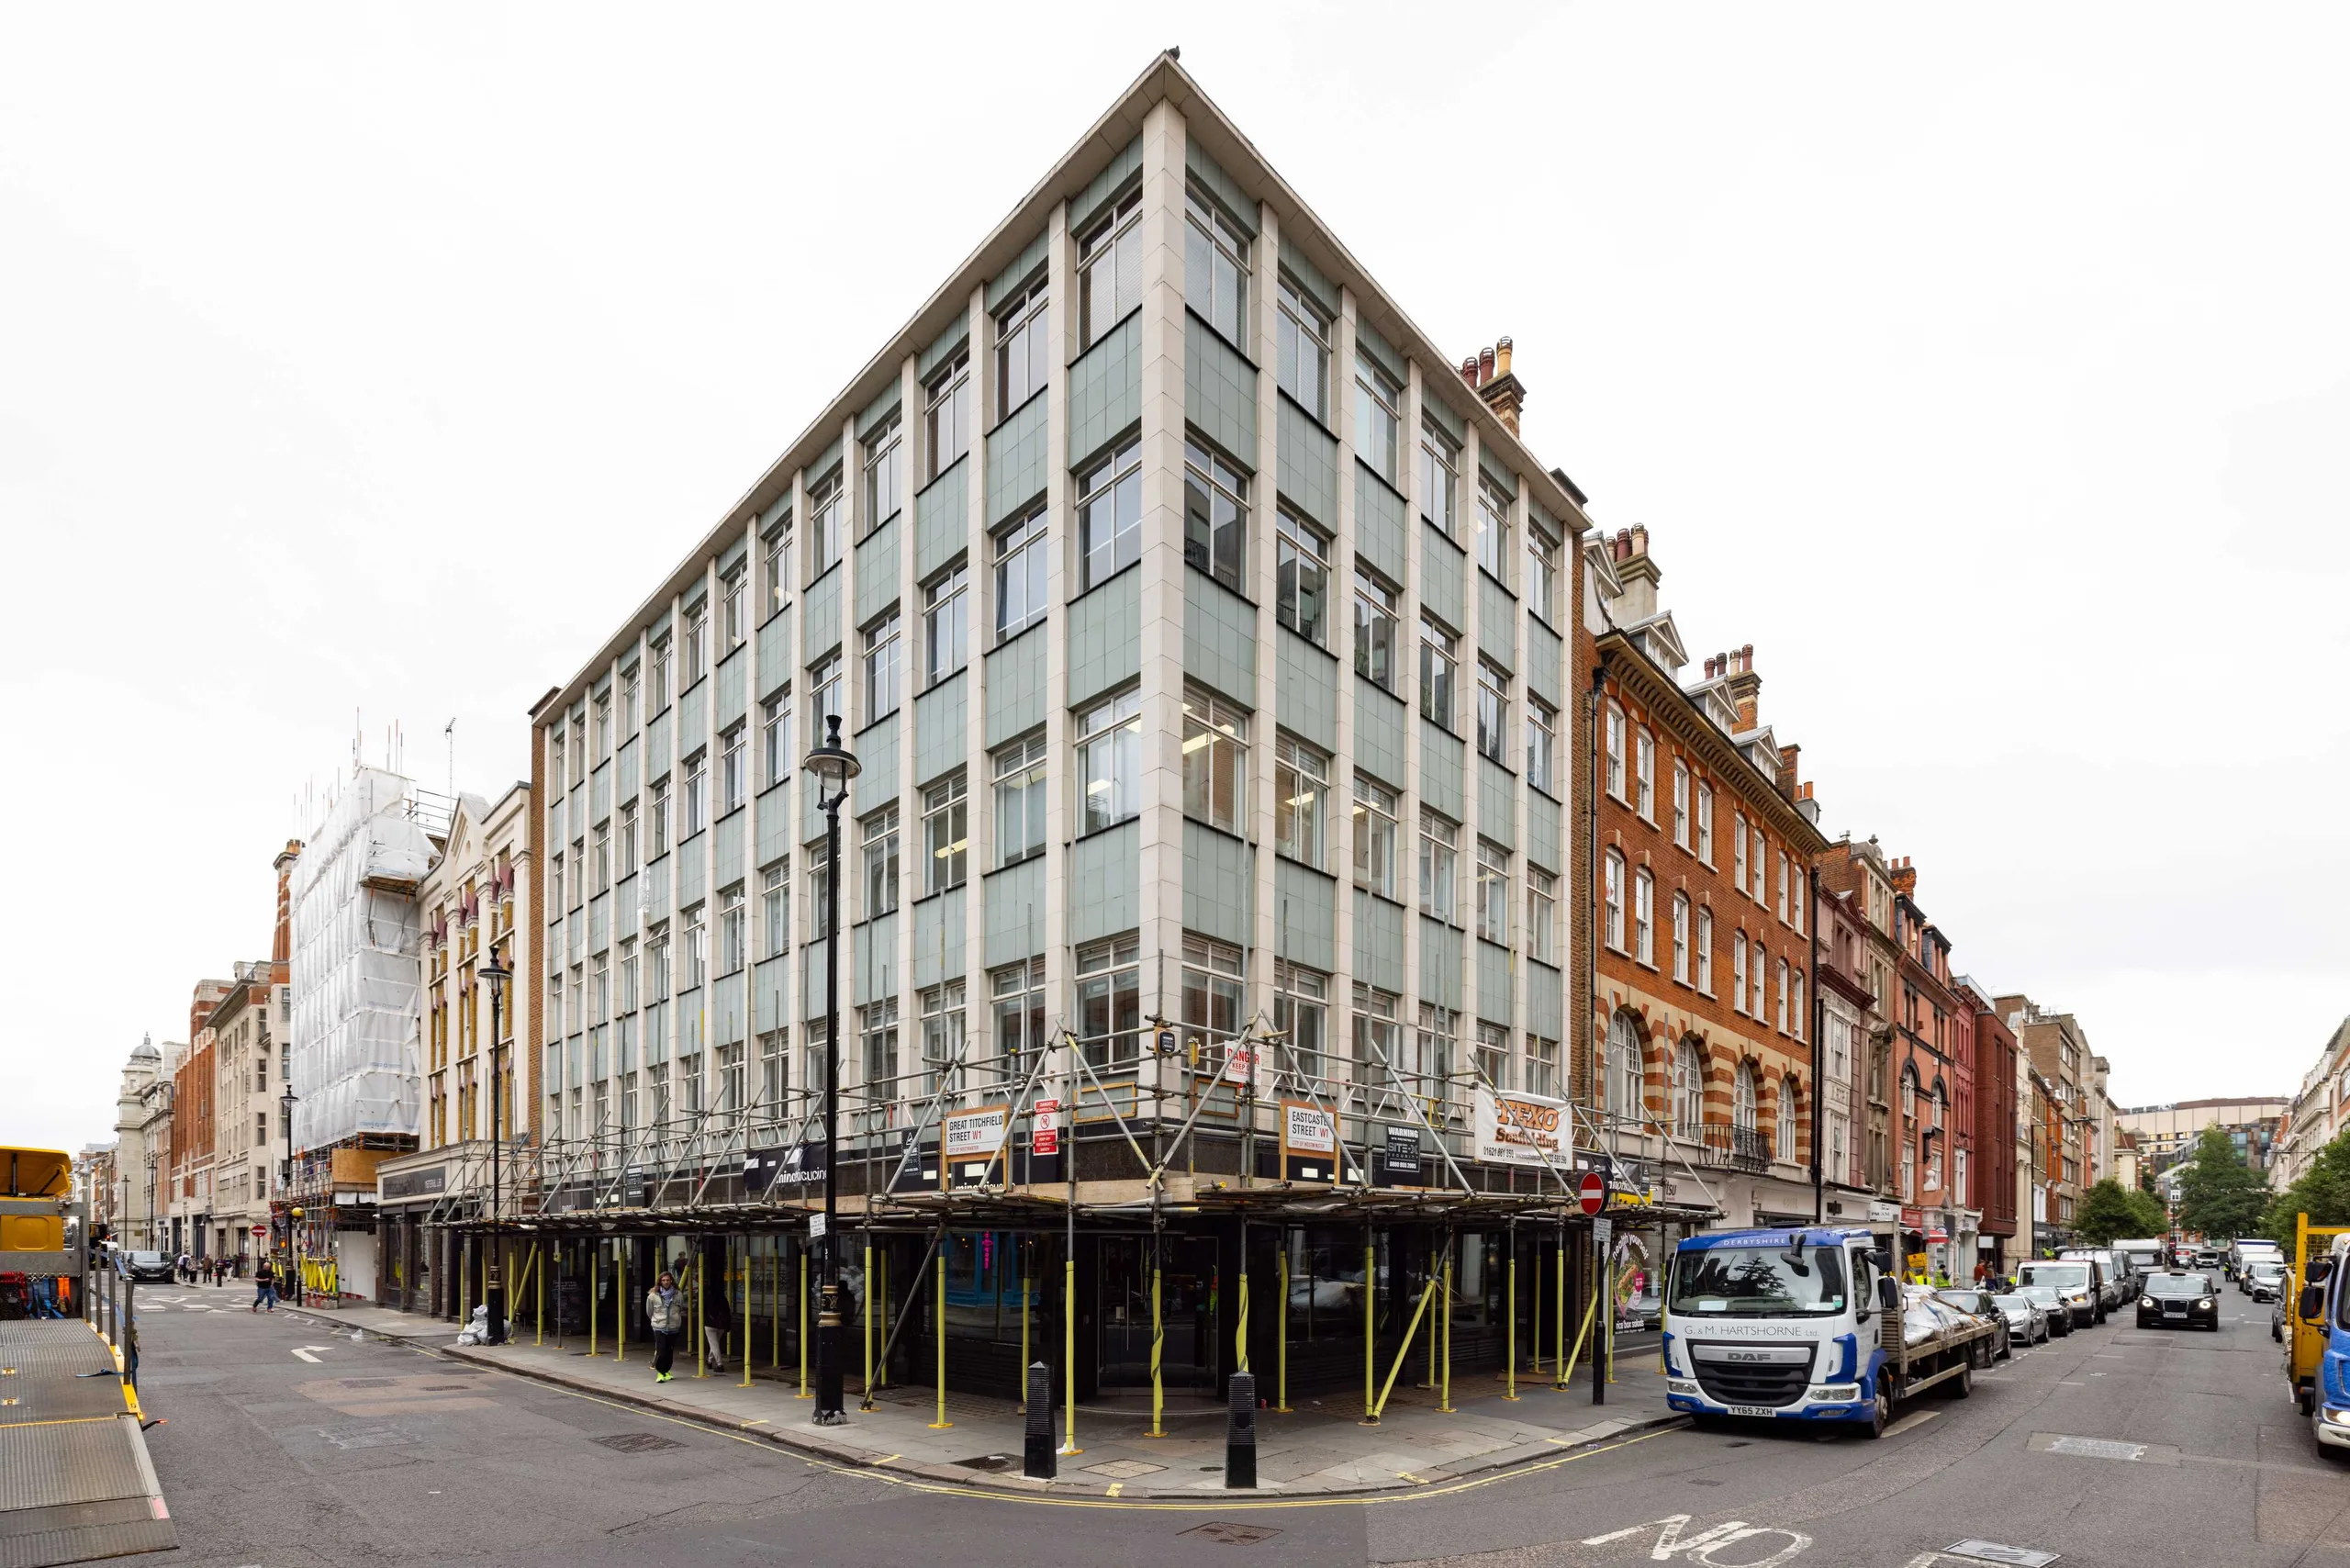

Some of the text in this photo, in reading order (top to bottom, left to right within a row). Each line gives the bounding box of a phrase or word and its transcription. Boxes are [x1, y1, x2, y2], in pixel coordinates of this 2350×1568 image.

[1227, 1048, 1259, 1065] DANGR
[1292, 1111, 1328, 1126] EASTCASTL
[1495, 1098, 1559, 1132] TEXO
[949, 1115, 1003, 1131] GREAT TITCHFIELD
[949, 1130, 982, 1142] STREET W1
[1292, 1124, 1328, 1138] STREET W1
[1388, 1127, 1418, 1138] WARNING
[1666, 1181, 1676, 1195] tsu
[1684, 1326, 1695, 1335] G.
[1705, 1326, 1717, 1335] M.
[1721, 1327, 1802, 1336] HARTSHORNE
[1728, 1353, 1771, 1361] DAF
[1731, 1406, 1773, 1416] YY65 ZXH
